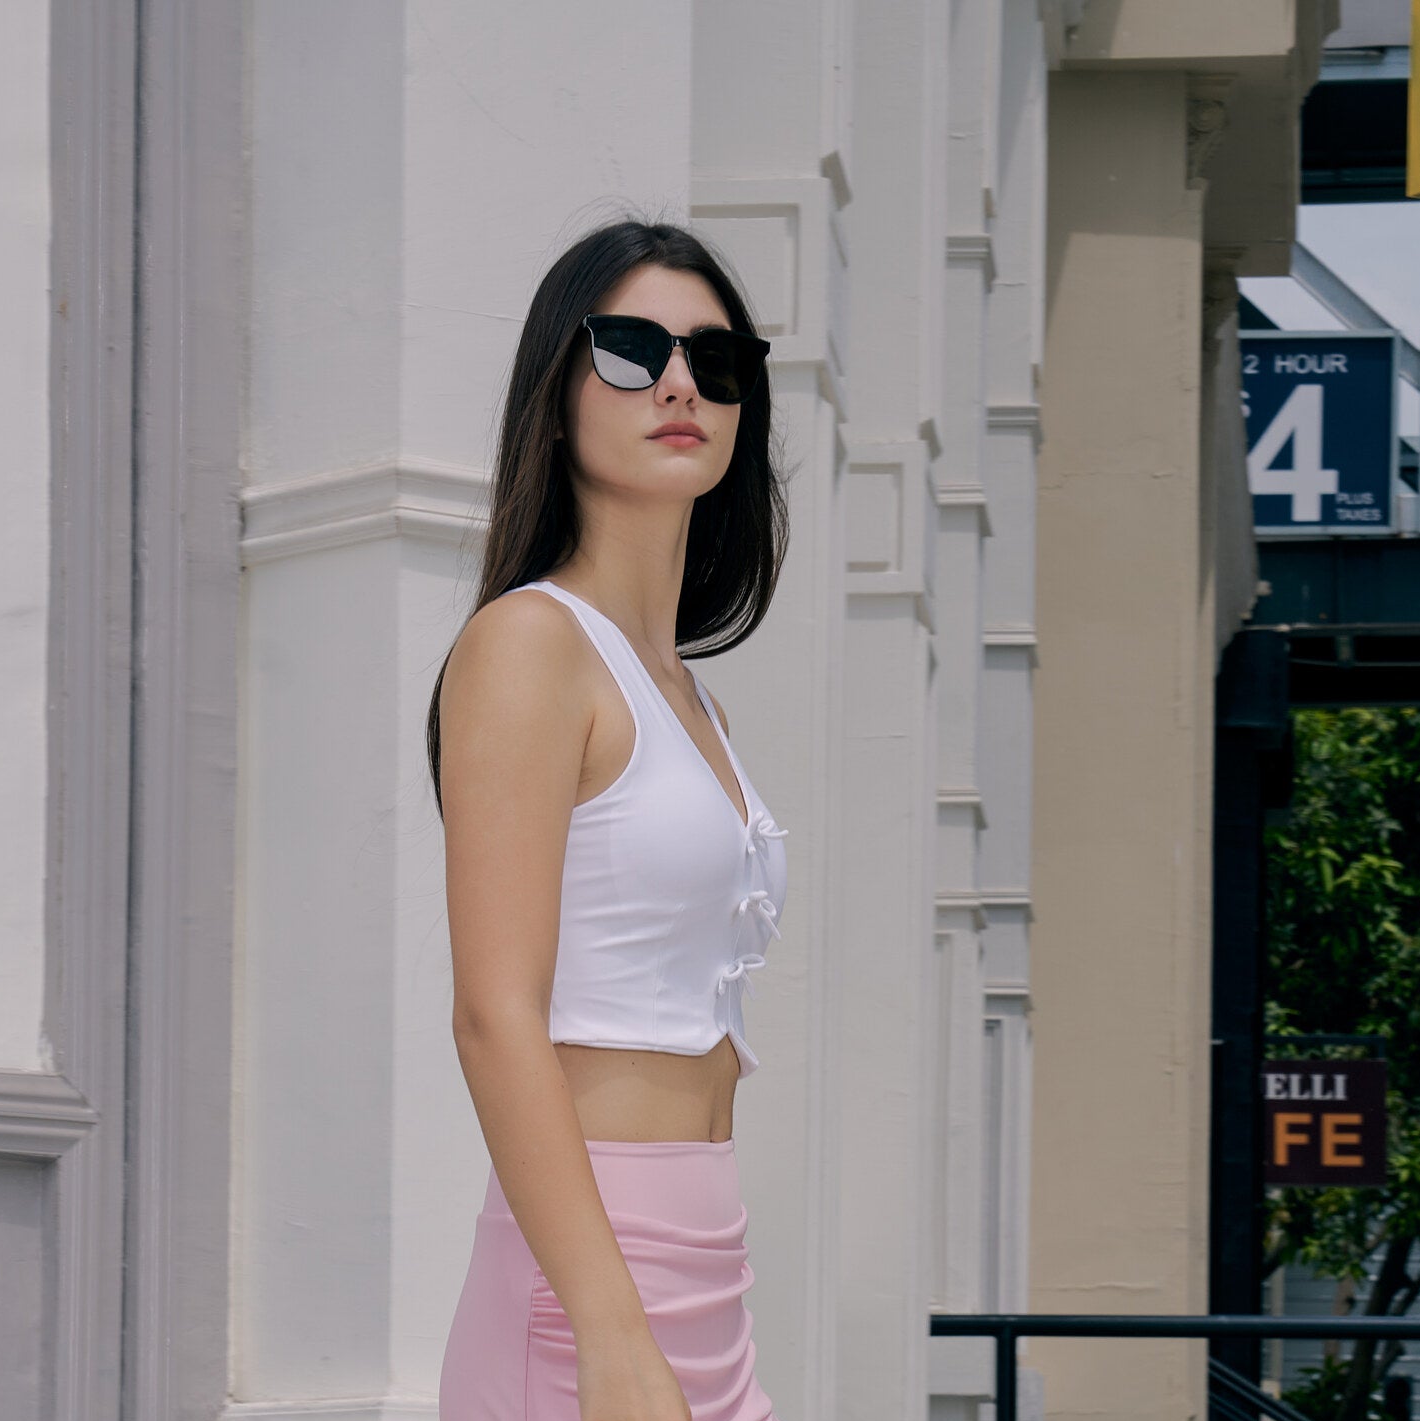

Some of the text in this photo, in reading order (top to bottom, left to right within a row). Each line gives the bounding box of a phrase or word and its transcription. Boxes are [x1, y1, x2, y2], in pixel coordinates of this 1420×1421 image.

[1242, 353, 1349, 374] 2 HOUR
[1335, 492, 1375, 505] PLUS
[1335, 508, 1382, 522] TAXES
[1273, 1112, 1364, 1167] FE
